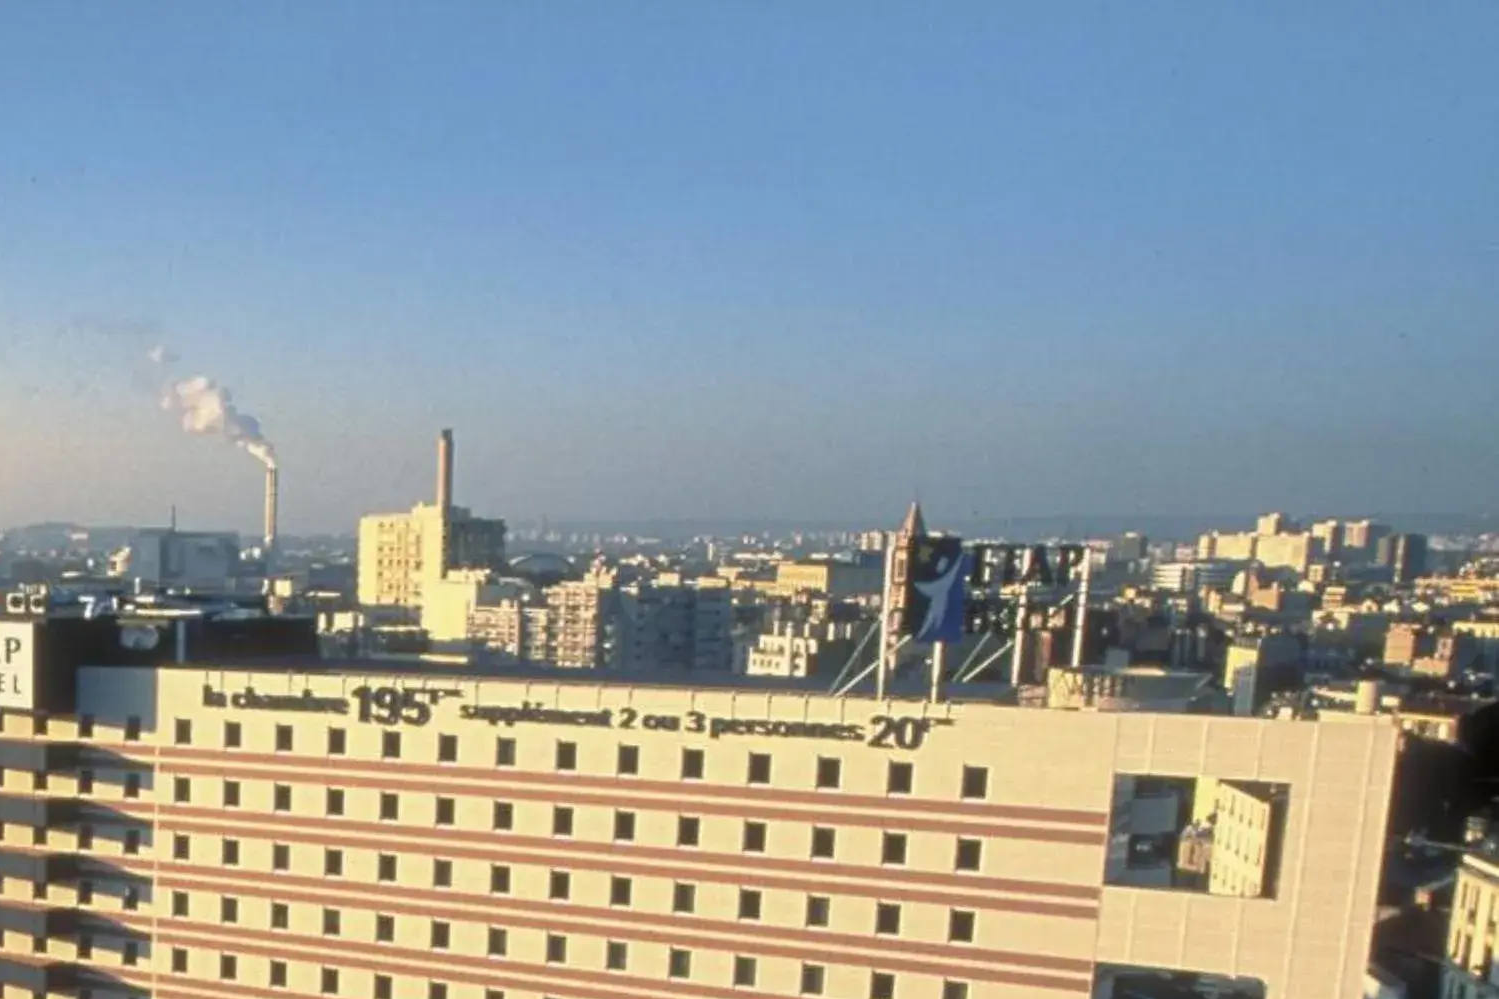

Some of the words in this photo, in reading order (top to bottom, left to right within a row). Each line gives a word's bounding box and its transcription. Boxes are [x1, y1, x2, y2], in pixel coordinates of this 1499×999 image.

[618, 707, 638, 729] 2
[642, 714, 681, 732] ou
[685, 711, 707, 733] 3
[710, 717, 866, 742] personnes
